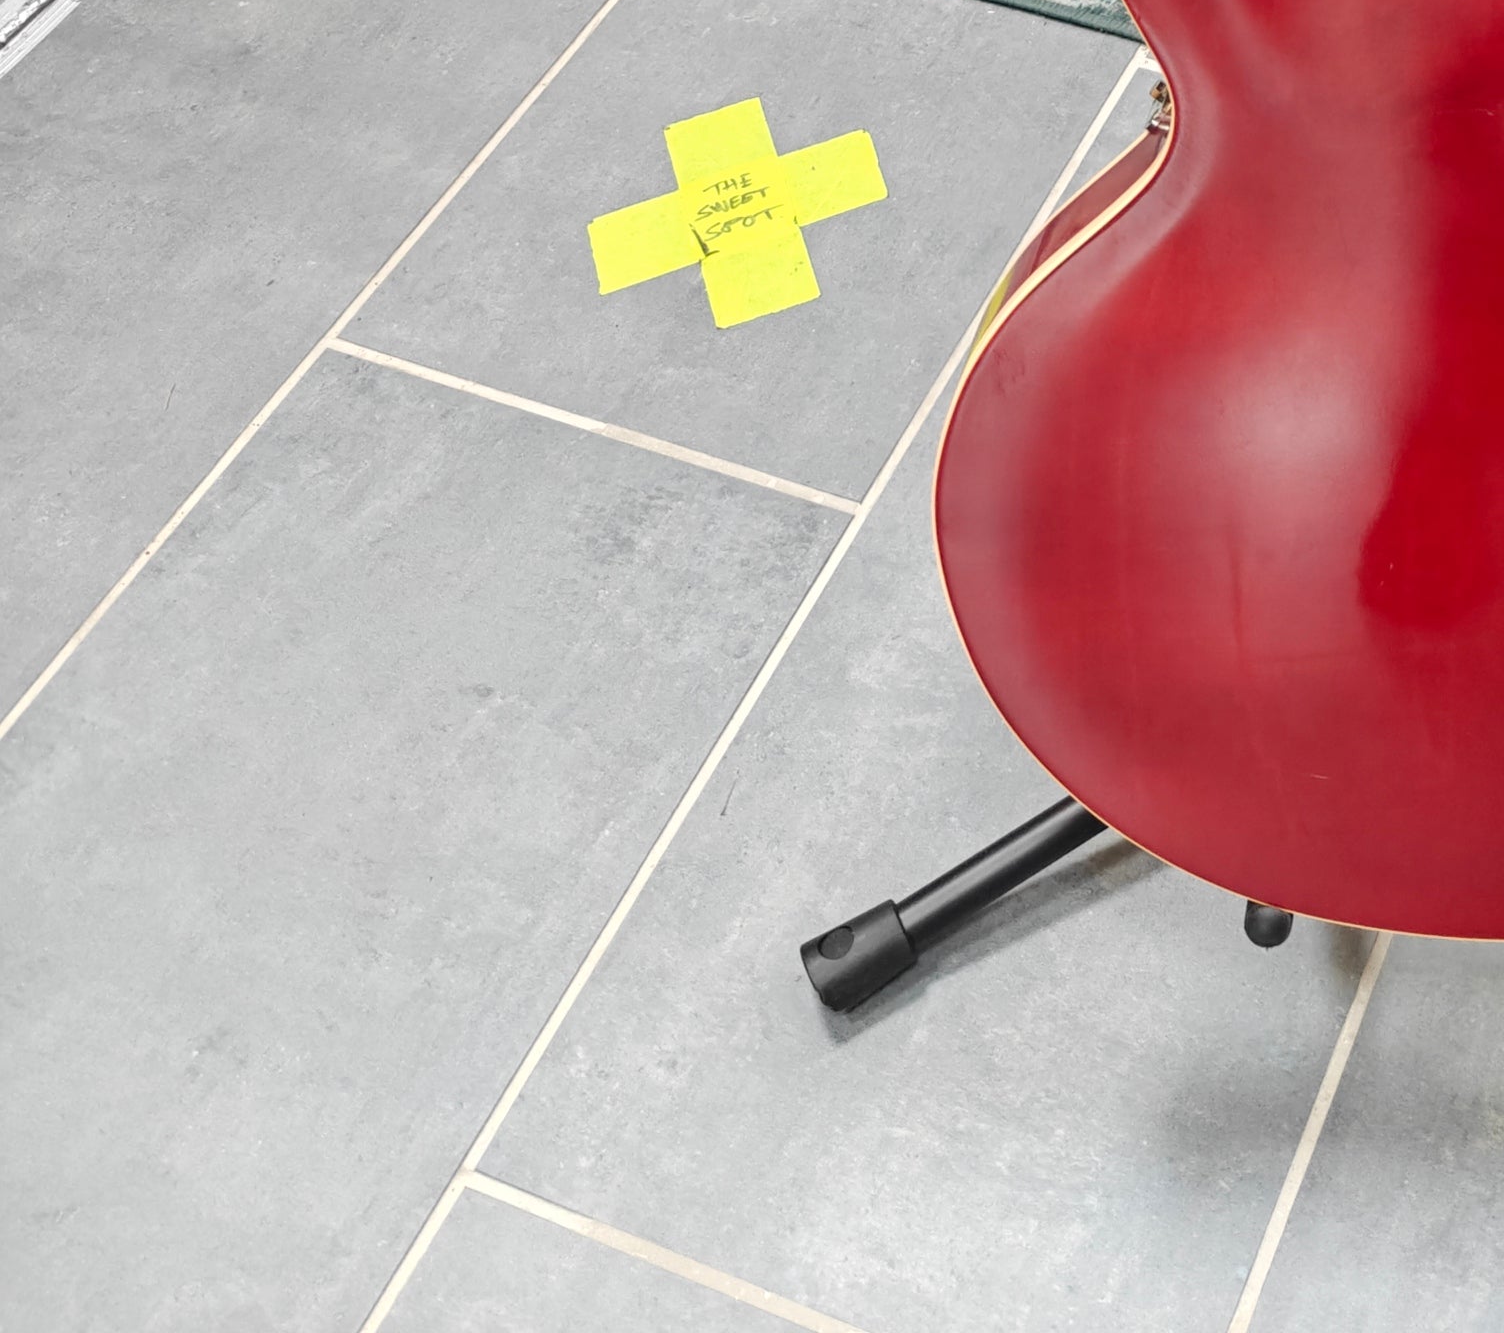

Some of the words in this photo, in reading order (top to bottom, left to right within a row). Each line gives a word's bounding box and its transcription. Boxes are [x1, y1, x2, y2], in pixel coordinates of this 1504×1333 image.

[703, 172, 752, 195] THE
[694, 186, 770, 222] SWEET
[703, 203, 785, 242] SPOT
